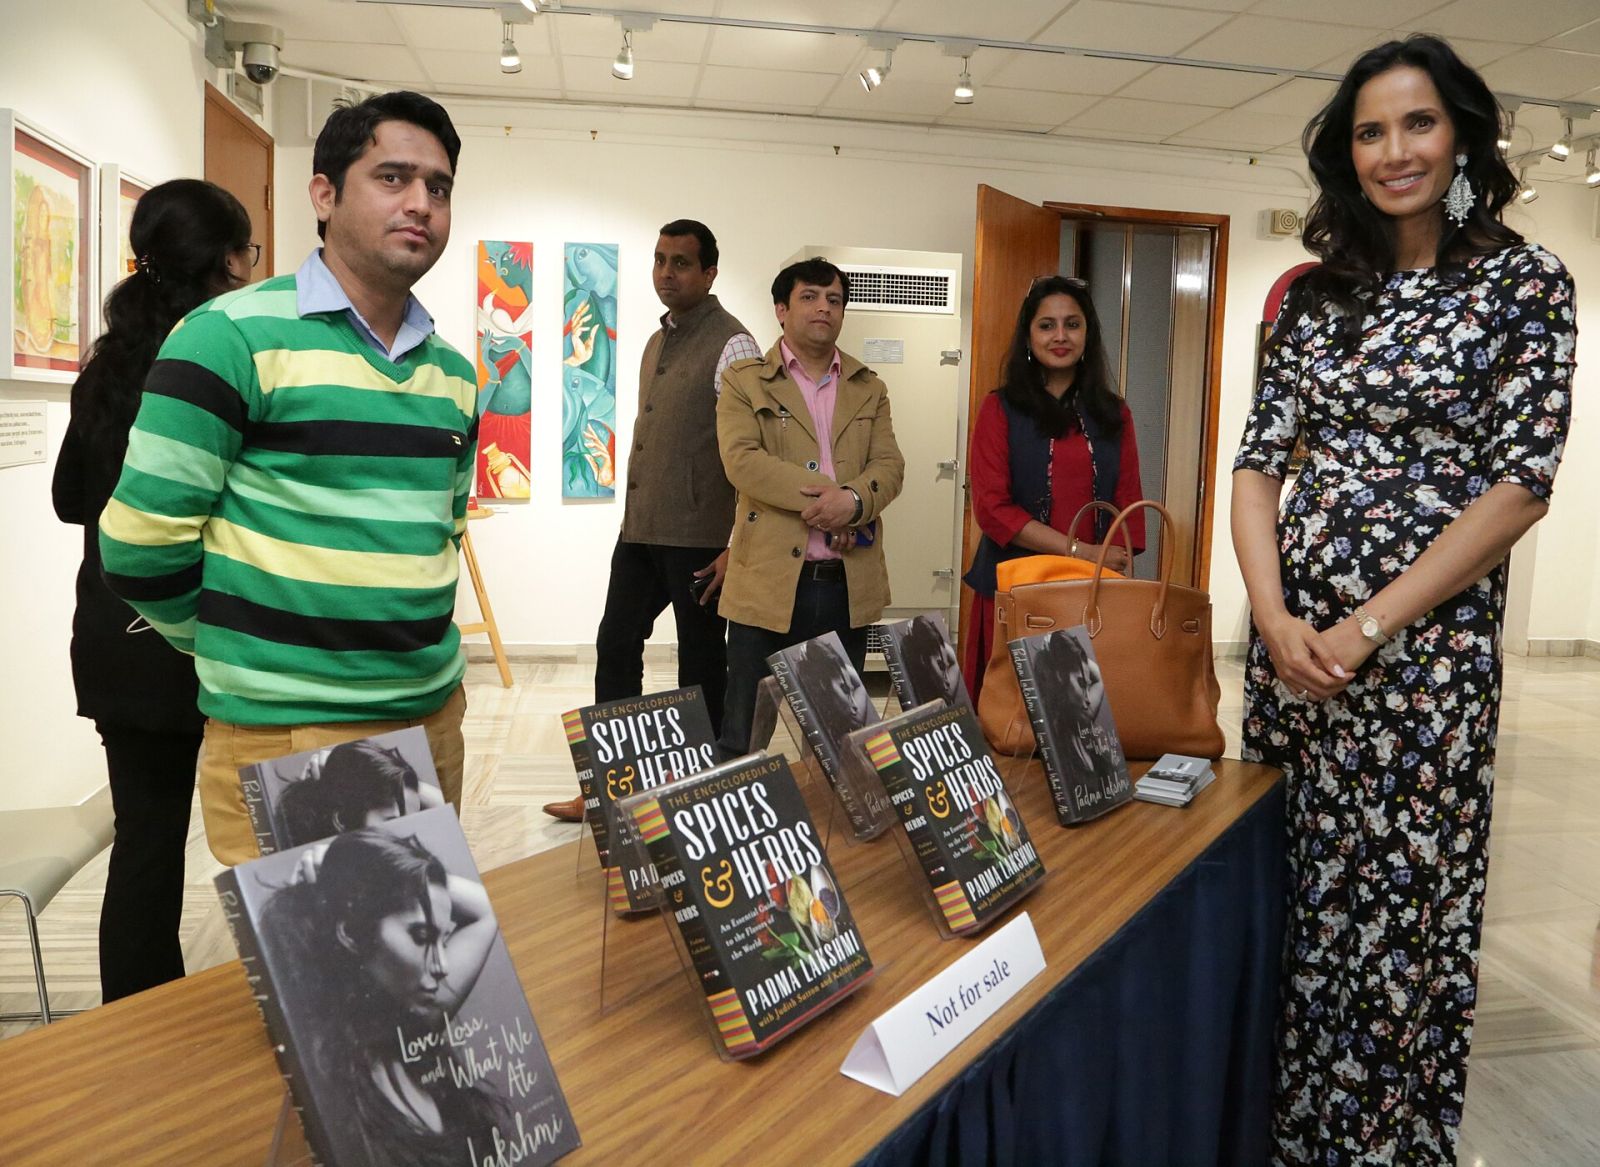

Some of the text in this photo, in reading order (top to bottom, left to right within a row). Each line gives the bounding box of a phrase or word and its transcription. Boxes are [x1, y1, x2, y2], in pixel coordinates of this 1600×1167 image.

[588, 690, 698, 720] THE ENCYCLOPEDIA OF
[772, 661, 790, 691] Padma
[785, 691, 808, 727] Lakshmi
[1012, 648, 1027, 677] Padma
[1020, 678, 1038, 713] Lakshmi
[591, 707, 686, 764] SPICES
[896, 730, 911, 740] THE
[912, 712, 960, 736] ENCYCLOPEDIA
[902, 722, 972, 781] SPICES
[607, 743, 716, 801] & HERBS
[668, 759, 783, 809] THE ENCYCLOPEDIA OF
[891, 788, 916, 805] SPICES
[925, 755, 1003, 819] & HERBS
[1074, 772, 1130, 812] Padma Lakshmi
[242, 780, 275, 856] Padma Lak
[673, 782, 778, 861] SPICES
[904, 815, 927, 832] HERBS
[629, 863, 660, 891] PAD
[660, 869, 686, 889] SPICES
[701, 821, 822, 908] & HERBS
[966, 841, 1037, 902] PADMA LAKSHMI
[675, 905, 699, 923] HERBS
[720, 923, 731, 934] An
[731, 908, 759, 925] Essential
[725, 914, 775, 947] to the Flavors of
[731, 938, 763, 961] the World
[745, 929, 860, 1016] PADMA LAKSHMI
[757, 1012, 775, 1028] with
[773, 1000, 798, 1021] Judith
[820, 976, 833, 989] and
[925, 958, 1011, 1036] Not for sale
[396, 1011, 489, 1063] Love, Loss,
[420, 1017, 533, 1089] and What We
[508, 1058, 538, 1098] Ate
[467, 1111, 563, 1167] Lakshmi
